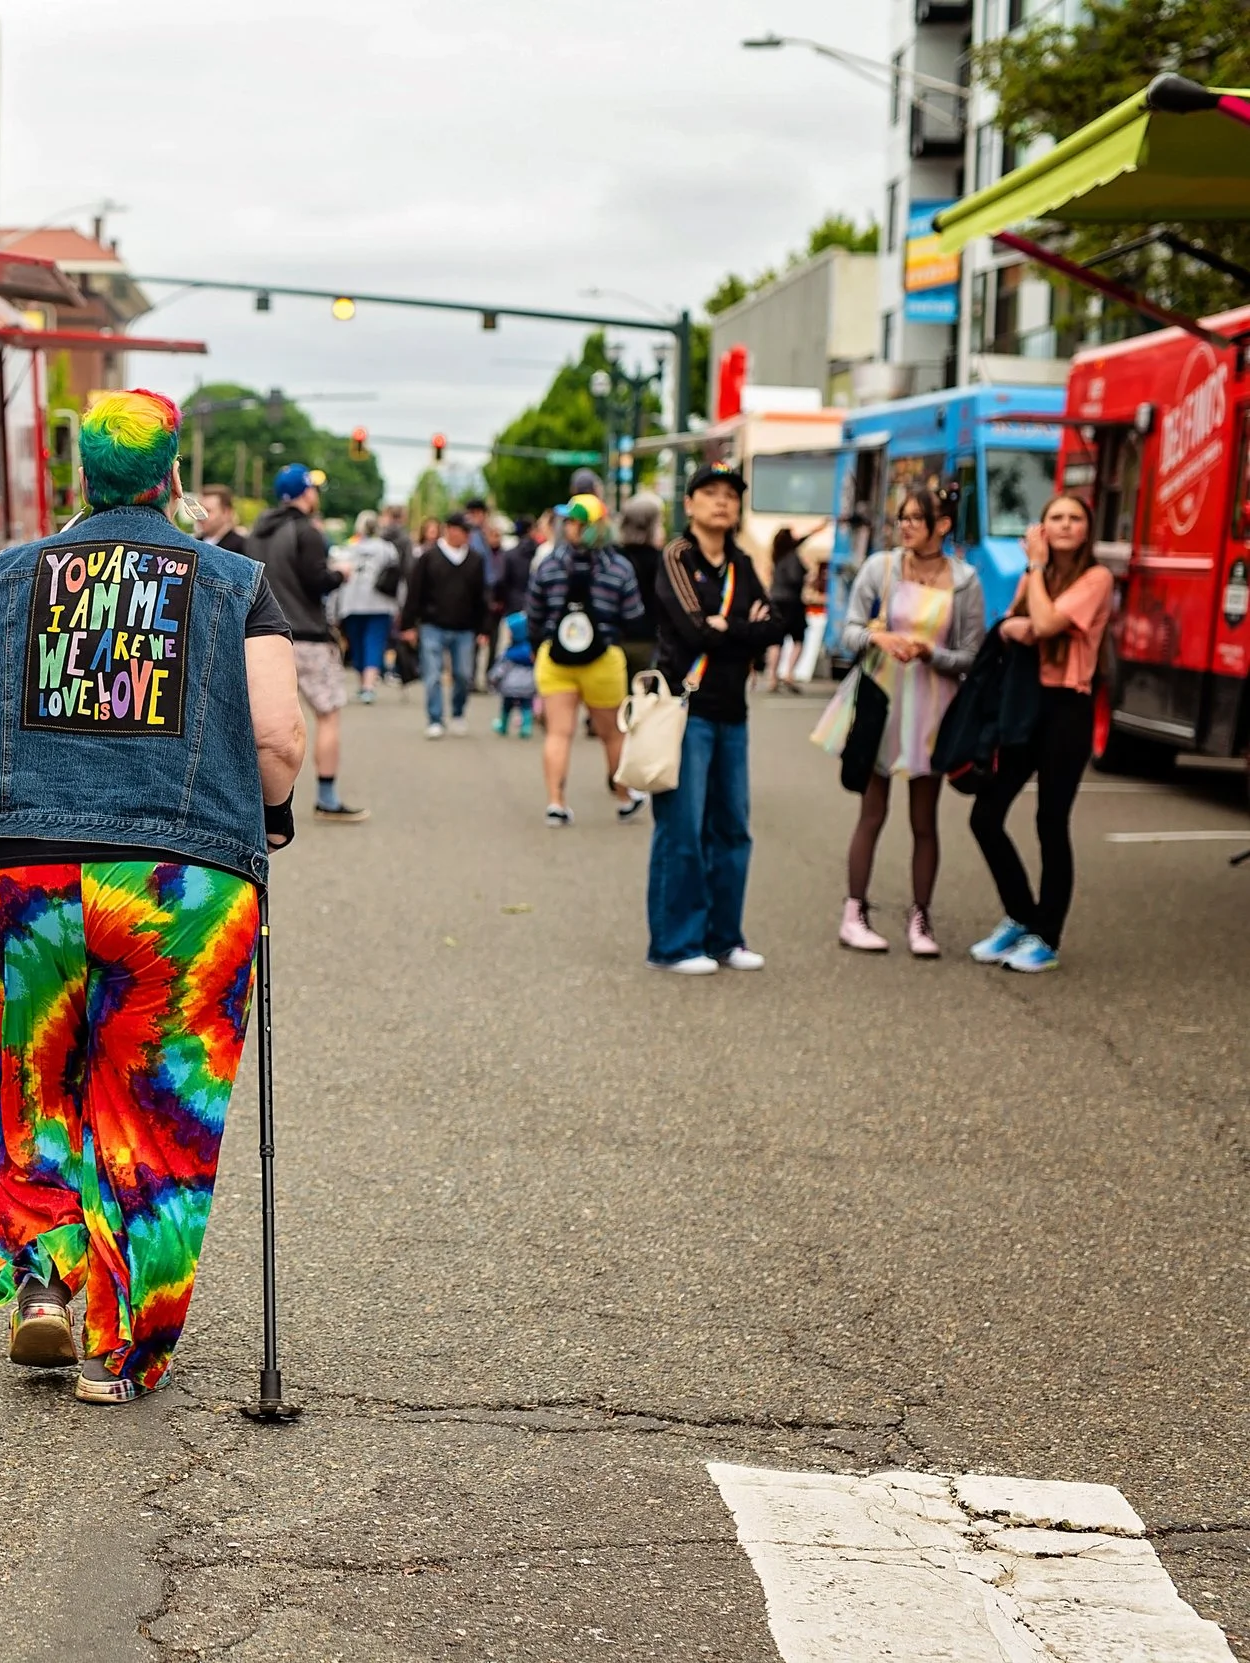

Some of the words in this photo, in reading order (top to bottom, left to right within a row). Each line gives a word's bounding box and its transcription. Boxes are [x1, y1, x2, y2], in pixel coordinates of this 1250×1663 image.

[46, 551, 105, 605] YOU
[101, 546, 152, 583] ARE
[156, 556, 188, 575] YOU
[47, 605, 65, 632] I
[69, 583, 119, 630] AM
[127, 577, 182, 632] ME
[38, 631, 87, 689] WE
[90, 629, 144, 672] ARE
[149, 634, 177, 660] WE
[39, 679, 93, 717] LOVE
[94, 703, 110, 721] IS
[98, 659, 169, 724] LOVE
